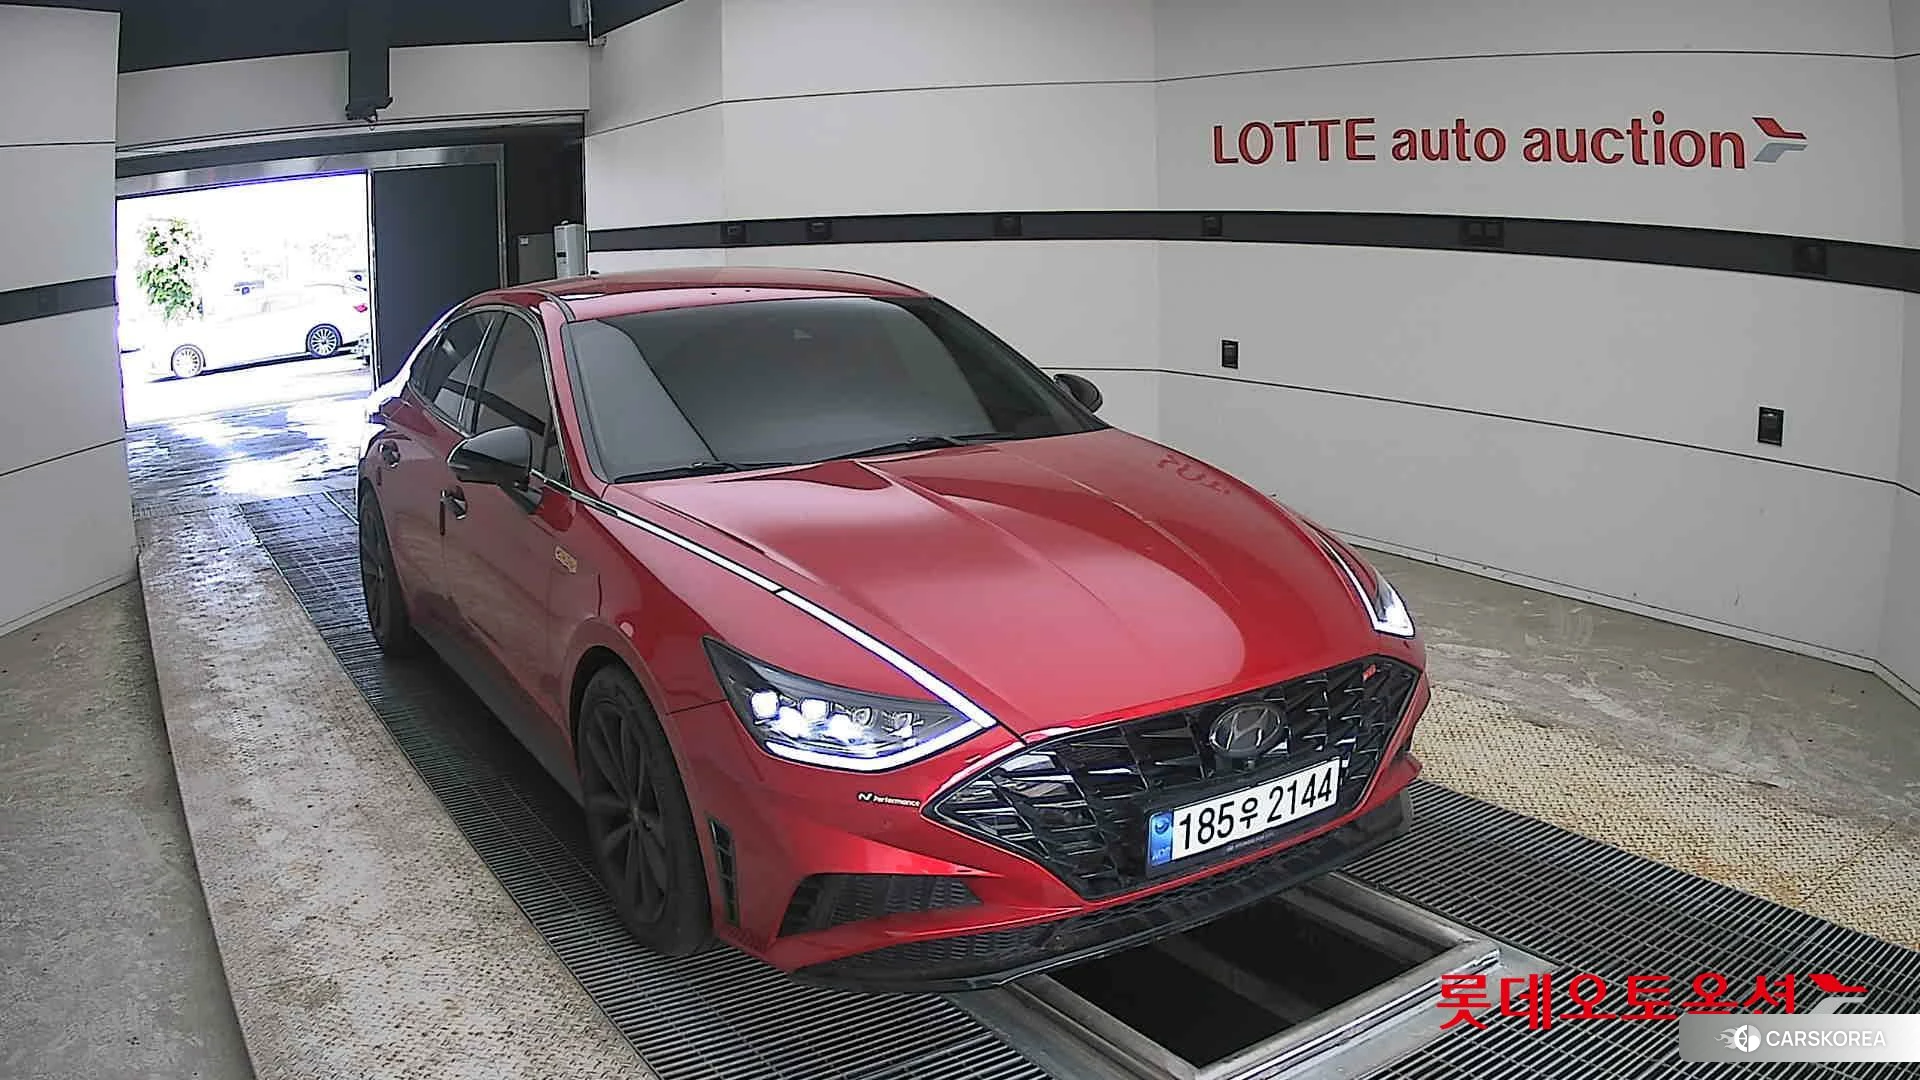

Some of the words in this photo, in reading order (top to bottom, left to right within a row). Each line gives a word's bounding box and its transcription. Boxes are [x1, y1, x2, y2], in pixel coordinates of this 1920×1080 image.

[1213, 117, 1376, 164] LOTTE
[1391, 118, 1507, 161] auto
[1522, 109, 1746, 169] auction
[1267, 767, 1332, 823] 2144
